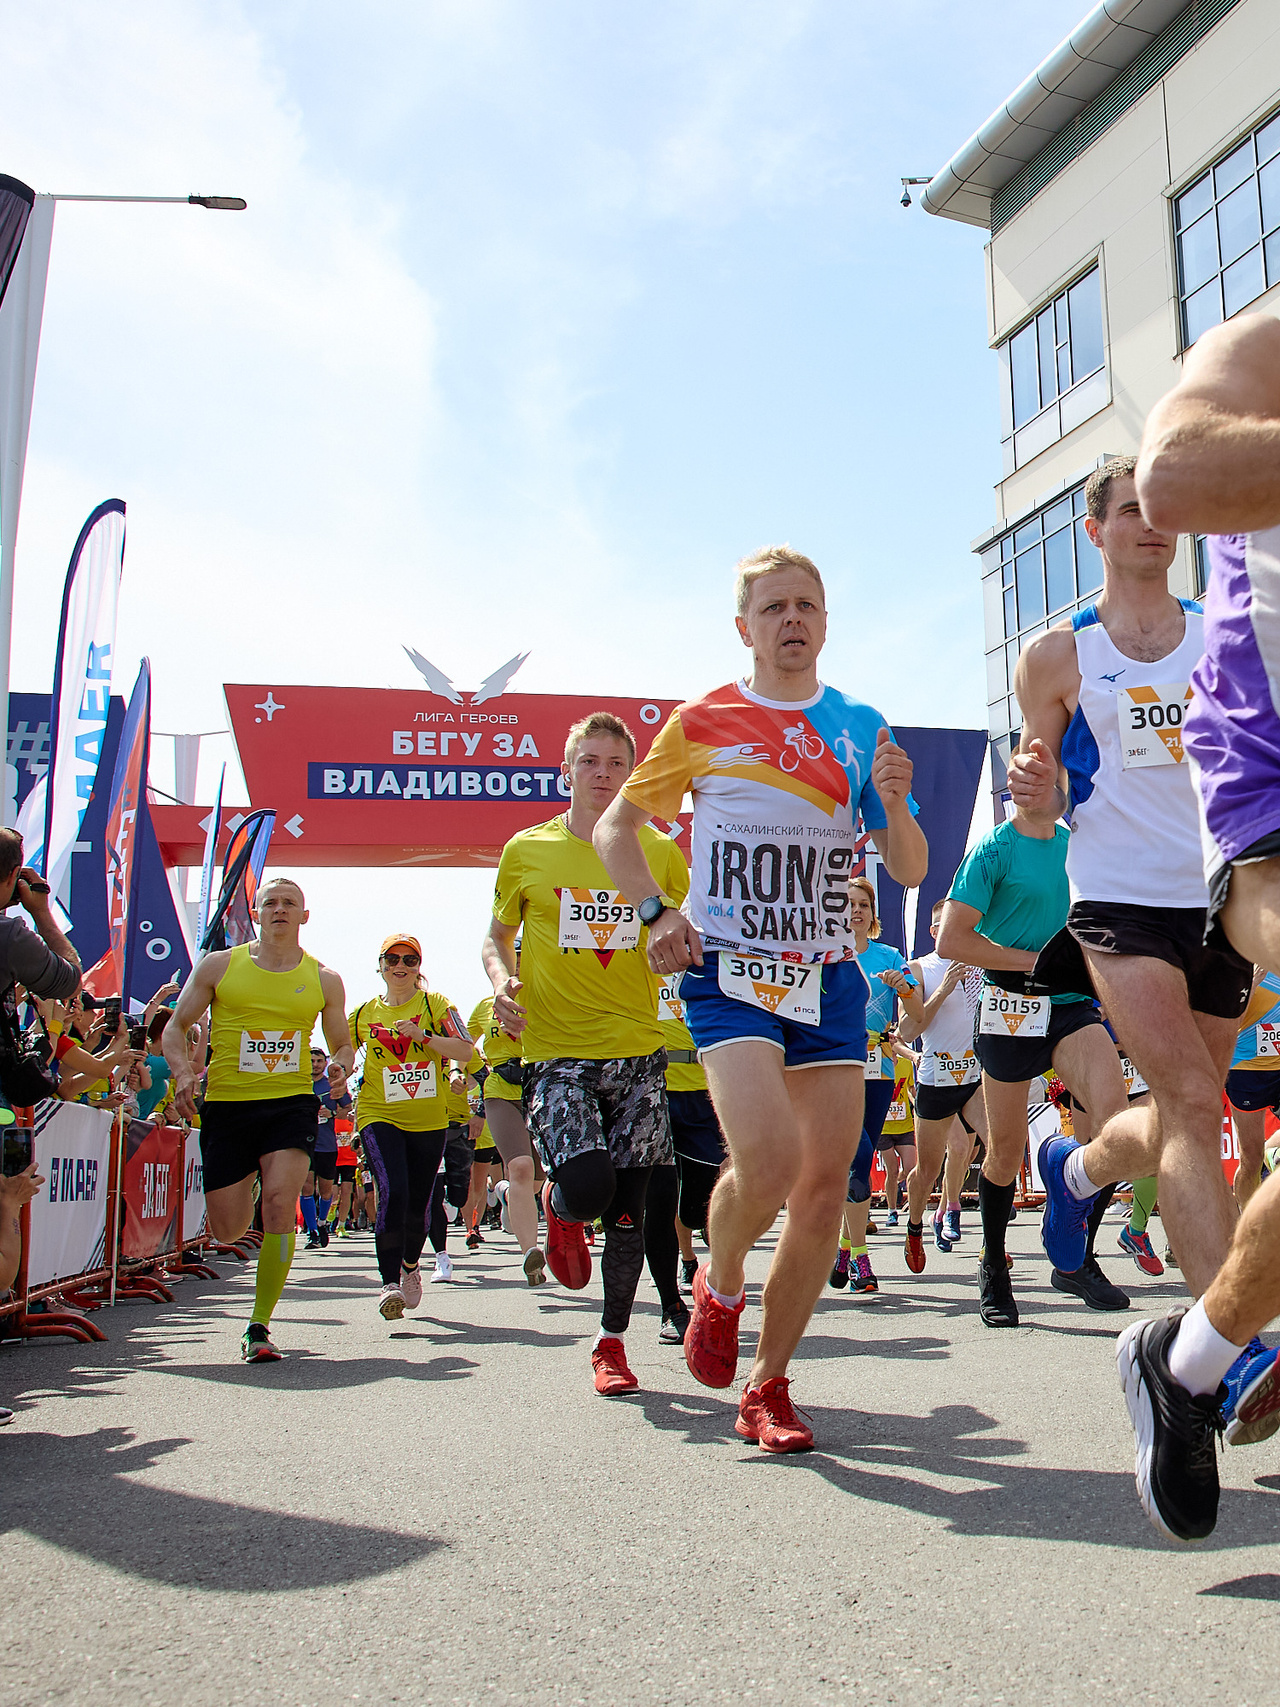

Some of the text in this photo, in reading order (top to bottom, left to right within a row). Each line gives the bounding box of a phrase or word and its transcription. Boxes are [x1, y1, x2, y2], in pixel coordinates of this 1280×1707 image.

[413, 712, 519, 724] ЛИГА ГЕРОЕВ
[1129, 703, 1190, 730] 300
[392, 730, 540, 758] БЕГУ ЗА
[323, 769, 572, 800] ВЛАДИВОСТО
[724, 823, 850, 840] САХАЛИНСКИЙ ТРИАТЛОН
[708, 840, 817, 904] IRON
[822, 848, 853, 937] 2019
[569, 904, 634, 923] 30593
[707, 904, 735, 919] vol.4
[741, 905, 816, 941] SAKH
[593, 929, 611, 939] 21,1
[730, 959, 811, 989] 30157
[758, 991, 780, 1005] 21,1
[988, 998, 1042, 1015] 30159
[1006, 1018, 1020, 1026] 21,1
[246, 1041, 295, 1053] 30399
[373, 1041, 425, 1060] RUN
[939, 1059, 976, 1071] 30539
[389, 1070, 430, 1085] 20250
